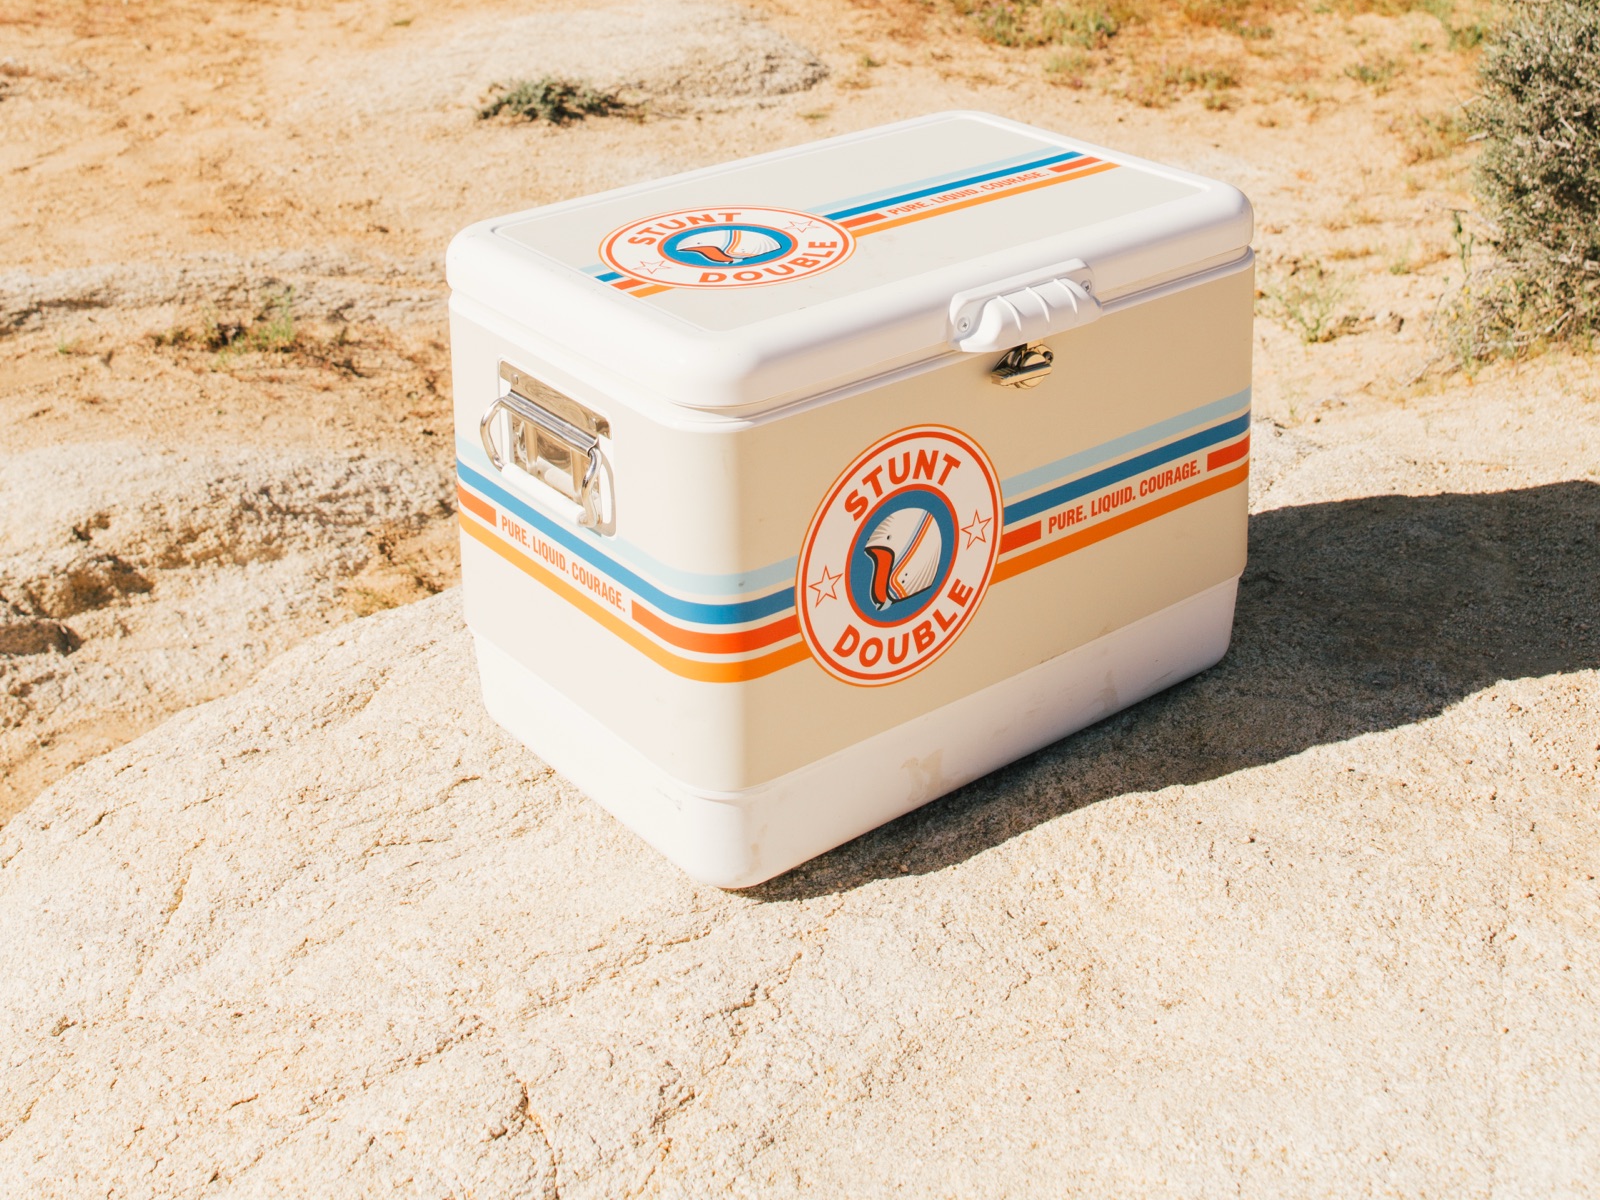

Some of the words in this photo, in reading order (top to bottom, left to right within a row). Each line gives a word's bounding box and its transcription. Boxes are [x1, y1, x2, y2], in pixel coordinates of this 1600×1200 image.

[627, 212, 742, 246] STUNT
[886, 201, 935, 216] PURE.
[930, 188, 984, 204] LIQUID.
[980, 171, 1051, 191] COURAGE.
[698, 241, 838, 284] DOUBLE
[844, 449, 962, 522] STUNT
[1048, 505, 1088, 534] PURE.
[1091, 486, 1136, 518] LIQUID.
[1139, 459, 1201, 497] COURAGE.
[501, 515, 531, 549] PURE.
[532, 535, 569, 574] LIQUID.
[571, 561, 626, 613] COURAGE.
[832, 578, 974, 668] DOUBLE
